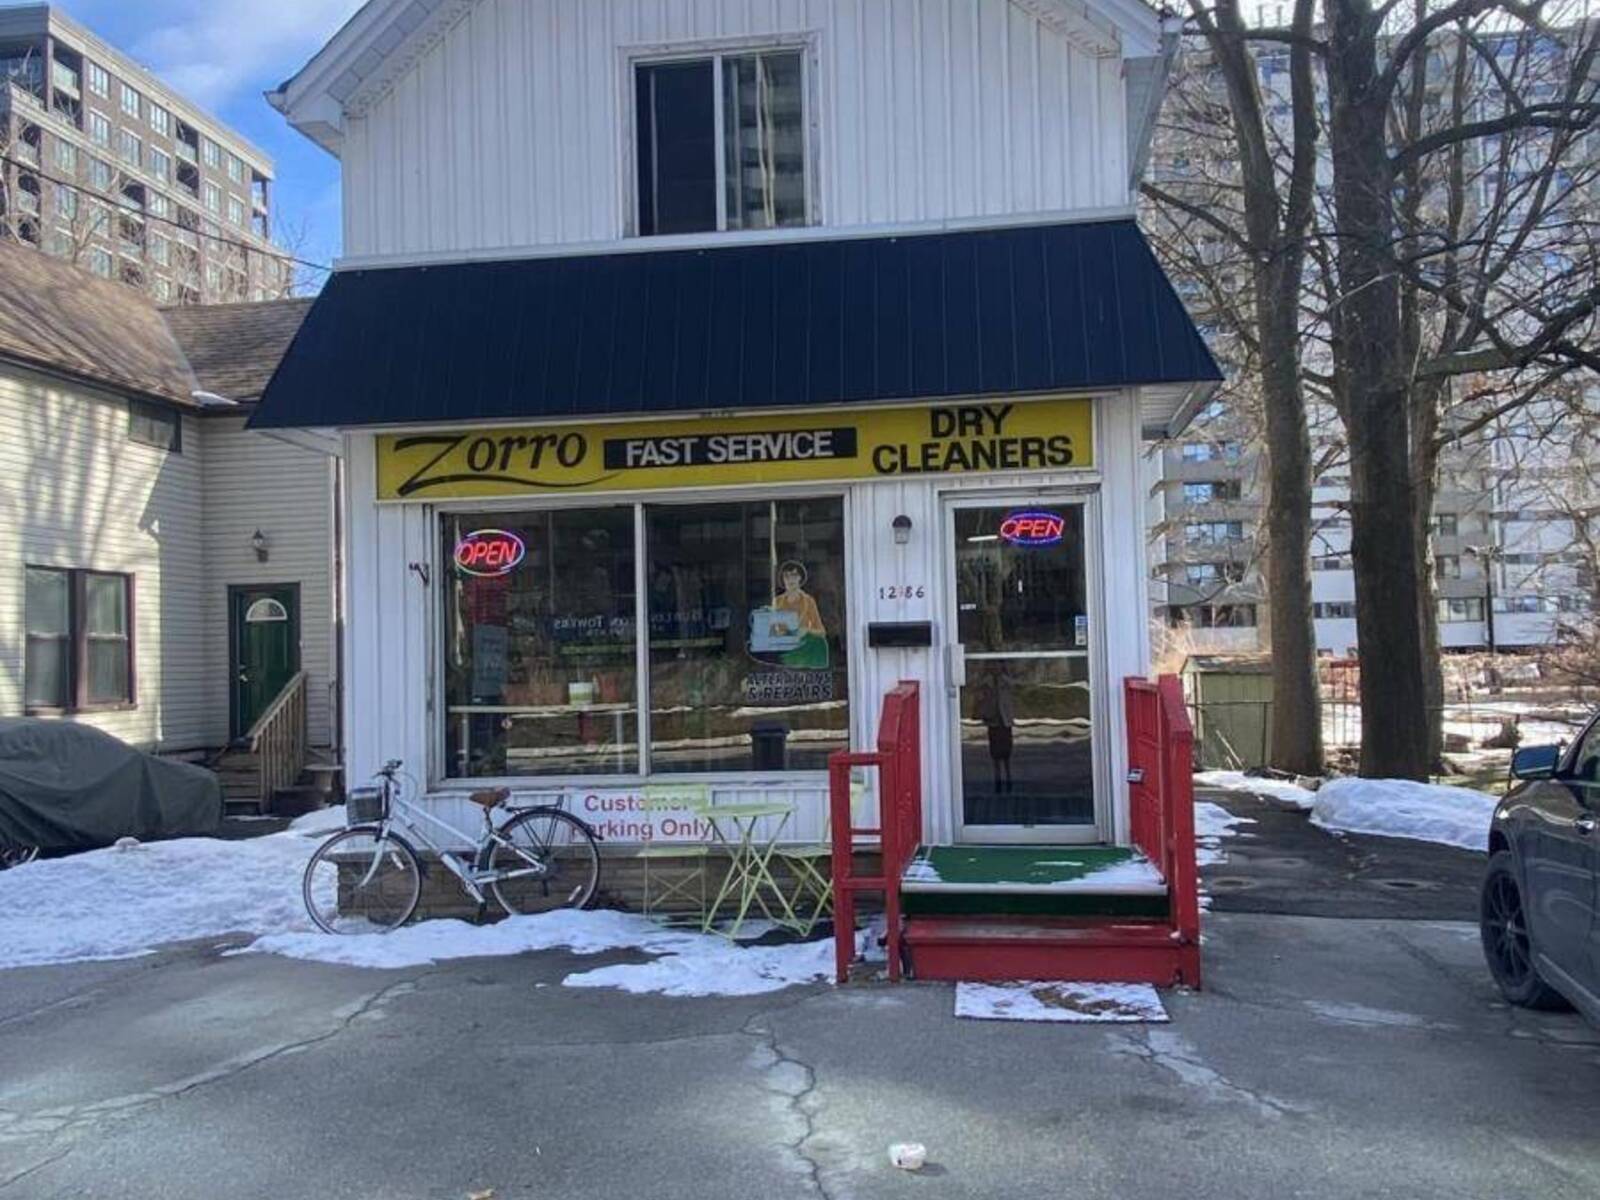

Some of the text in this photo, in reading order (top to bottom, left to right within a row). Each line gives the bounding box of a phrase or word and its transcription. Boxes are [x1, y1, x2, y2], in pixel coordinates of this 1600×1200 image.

[930, 403, 1014, 438] DRY
[626, 431, 833, 467] FAST SERVICE
[872, 435, 1074, 474] CLEANERS
[394, 432, 621, 497] Zorro
[1000, 519, 1065, 538] OPEN
[457, 540, 517, 566] OPEN
[763, 683, 833, 699] REPAIRS
[661, 818, 712, 840] Only
